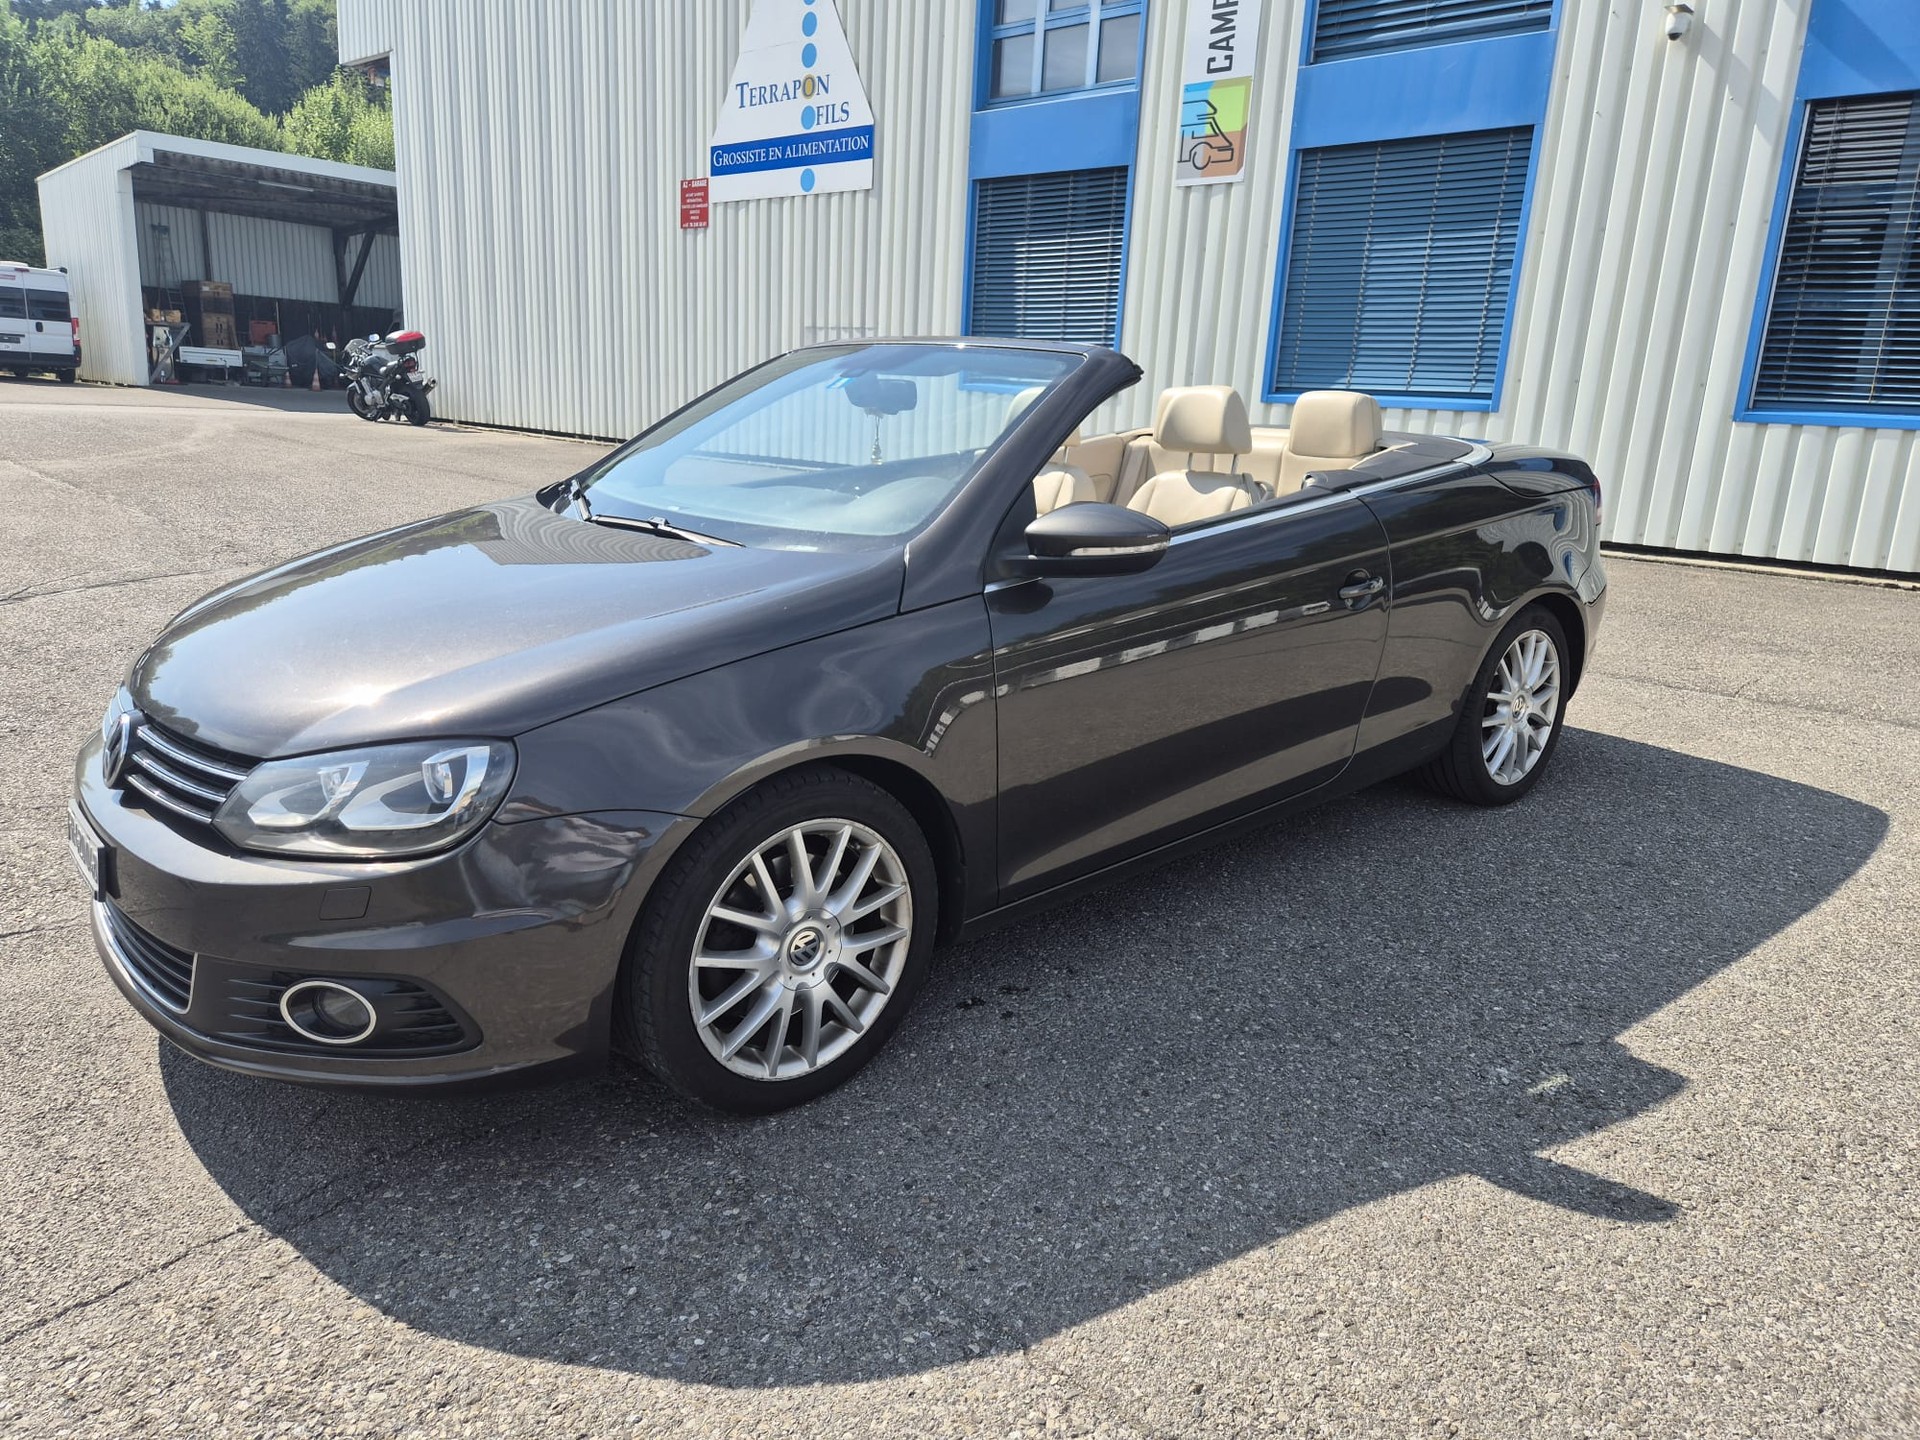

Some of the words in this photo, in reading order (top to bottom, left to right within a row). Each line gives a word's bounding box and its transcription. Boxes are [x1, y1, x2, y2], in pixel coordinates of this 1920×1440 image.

[735, 74, 830, 109] TERRAPON
[816, 101, 850, 126] FILS
[713, 149, 766, 167] GROSSISTE
[769, 146, 782, 160] EN
[785, 135, 870, 159] ALIMENTATION
